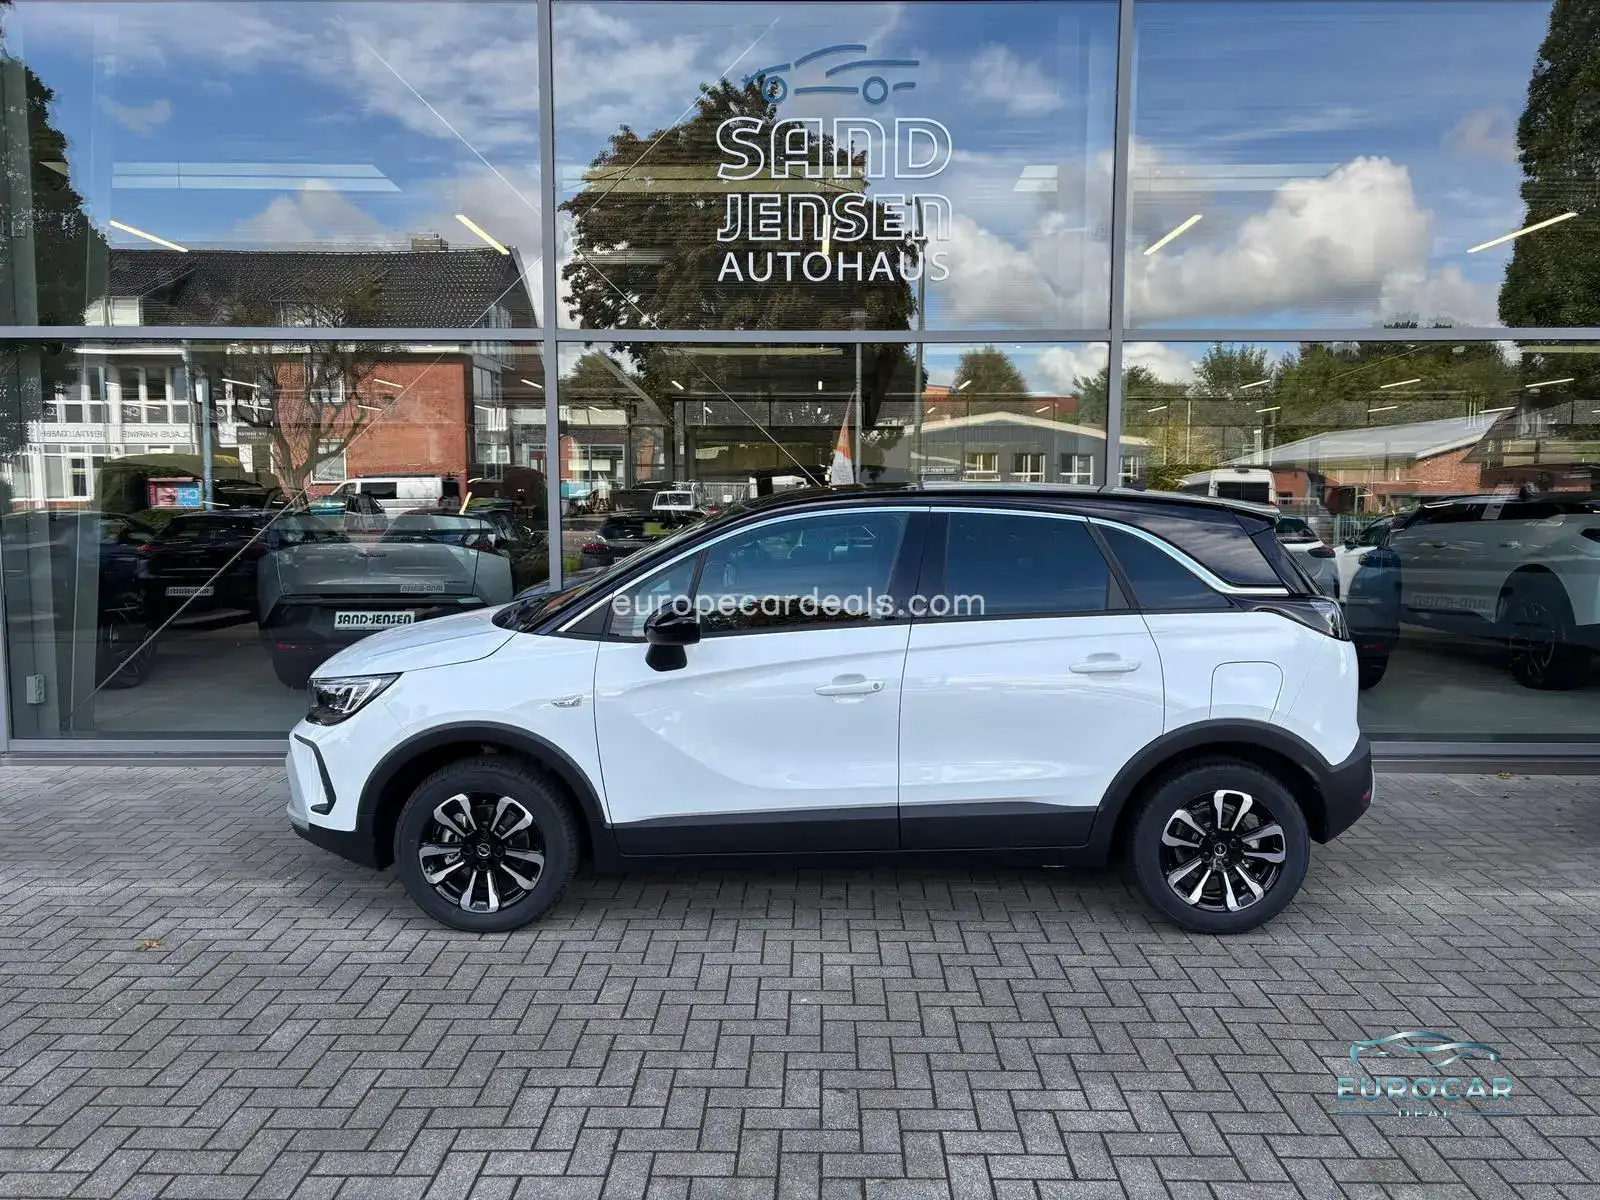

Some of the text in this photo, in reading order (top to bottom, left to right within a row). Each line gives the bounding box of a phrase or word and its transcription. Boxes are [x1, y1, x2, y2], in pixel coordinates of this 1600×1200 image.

[716, 116, 952, 180] SAND
[717, 193, 952, 242] JENSEN
[717, 251, 951, 282] AUTOHAUS
